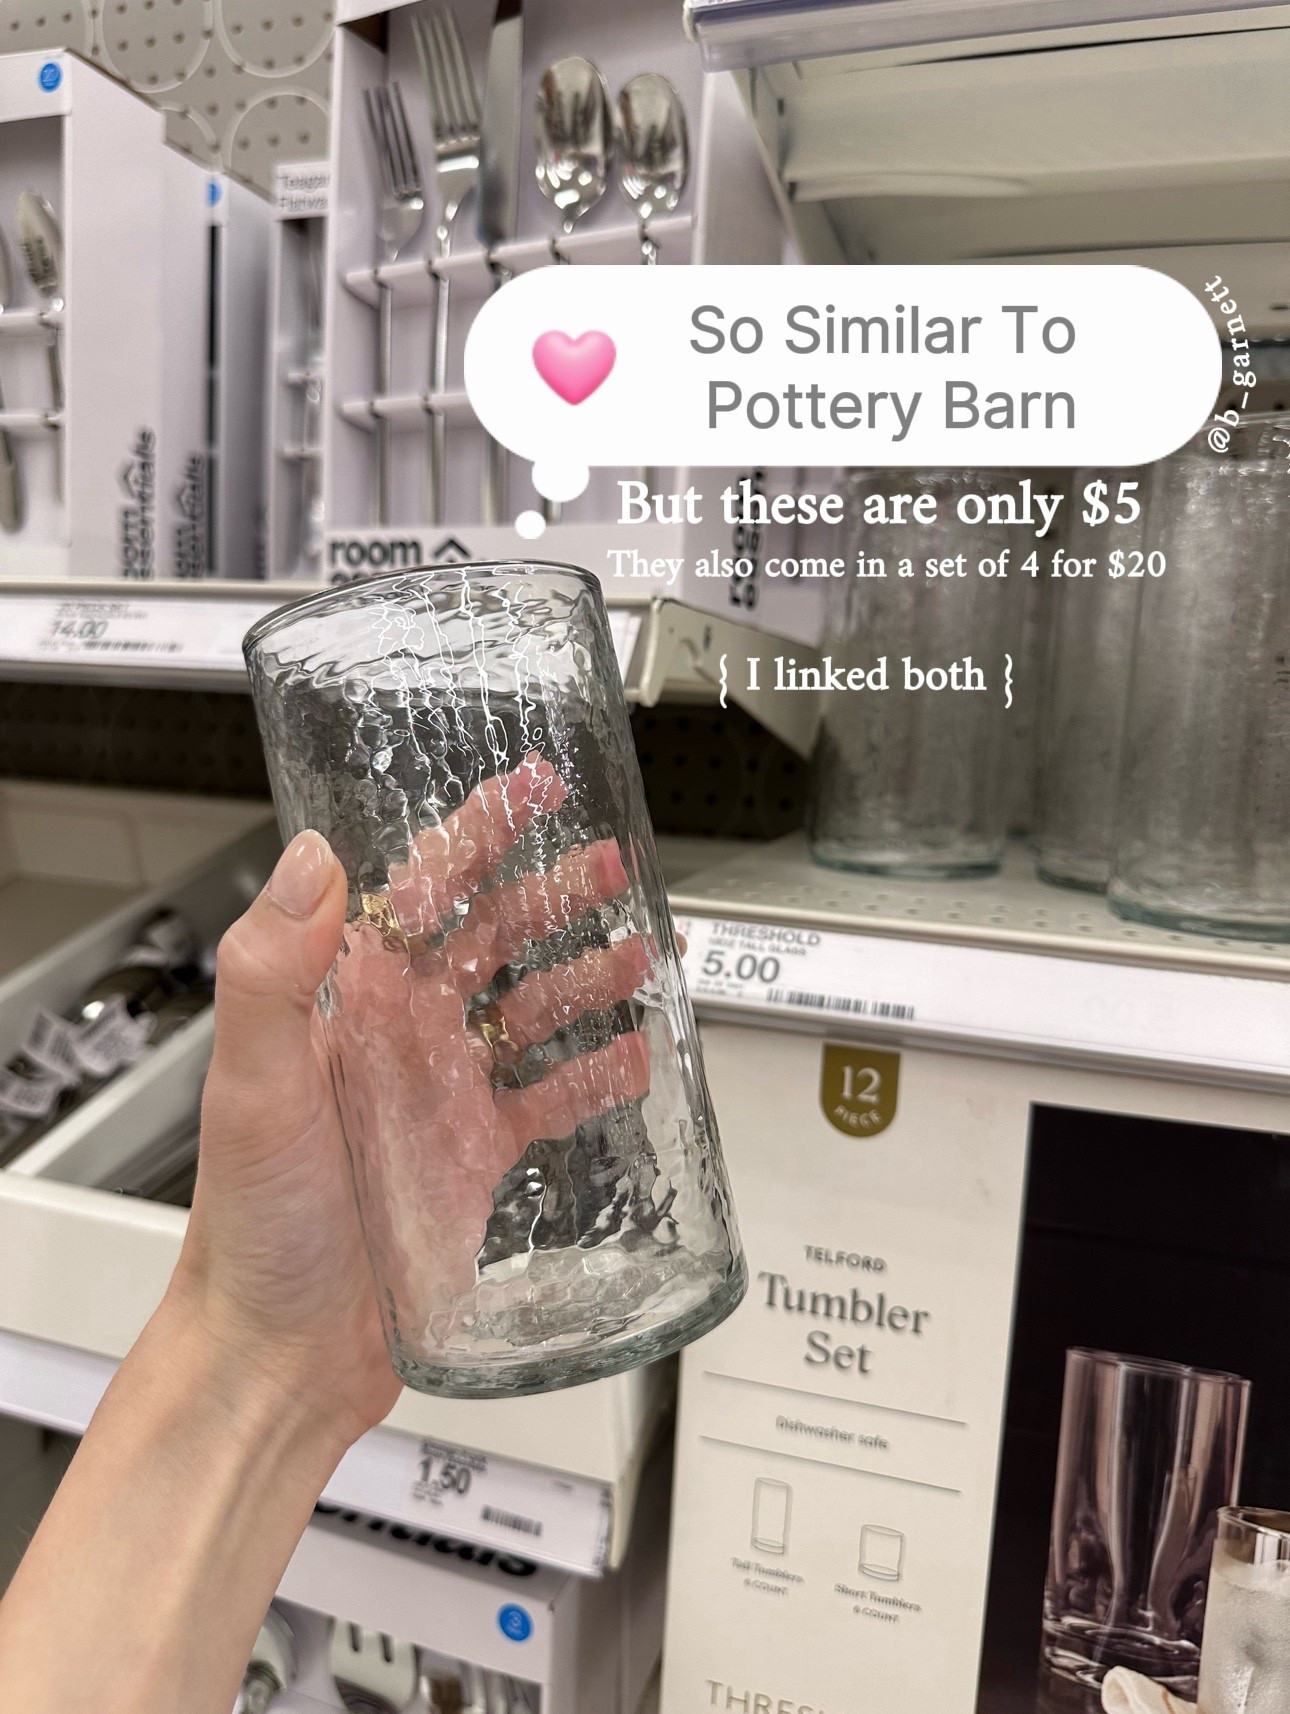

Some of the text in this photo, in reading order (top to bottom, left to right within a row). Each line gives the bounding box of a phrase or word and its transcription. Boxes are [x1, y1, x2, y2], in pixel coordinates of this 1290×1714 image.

[331, 541, 422, 566] room
[51, 619, 109, 640] 14.00
[711, 922, 821, 946] THRESHOLD
[702, 951, 781, 984] 5.00
[842, 1064, 882, 1104] 12
[833, 1104, 882, 1129] PIECE
[804, 1245, 888, 1272] TELFORD
[757, 1270, 931, 1335] Tumbler
[803, 1330, 872, 1375] Set
[775, 1415, 889, 1450] Dishwasher safe
